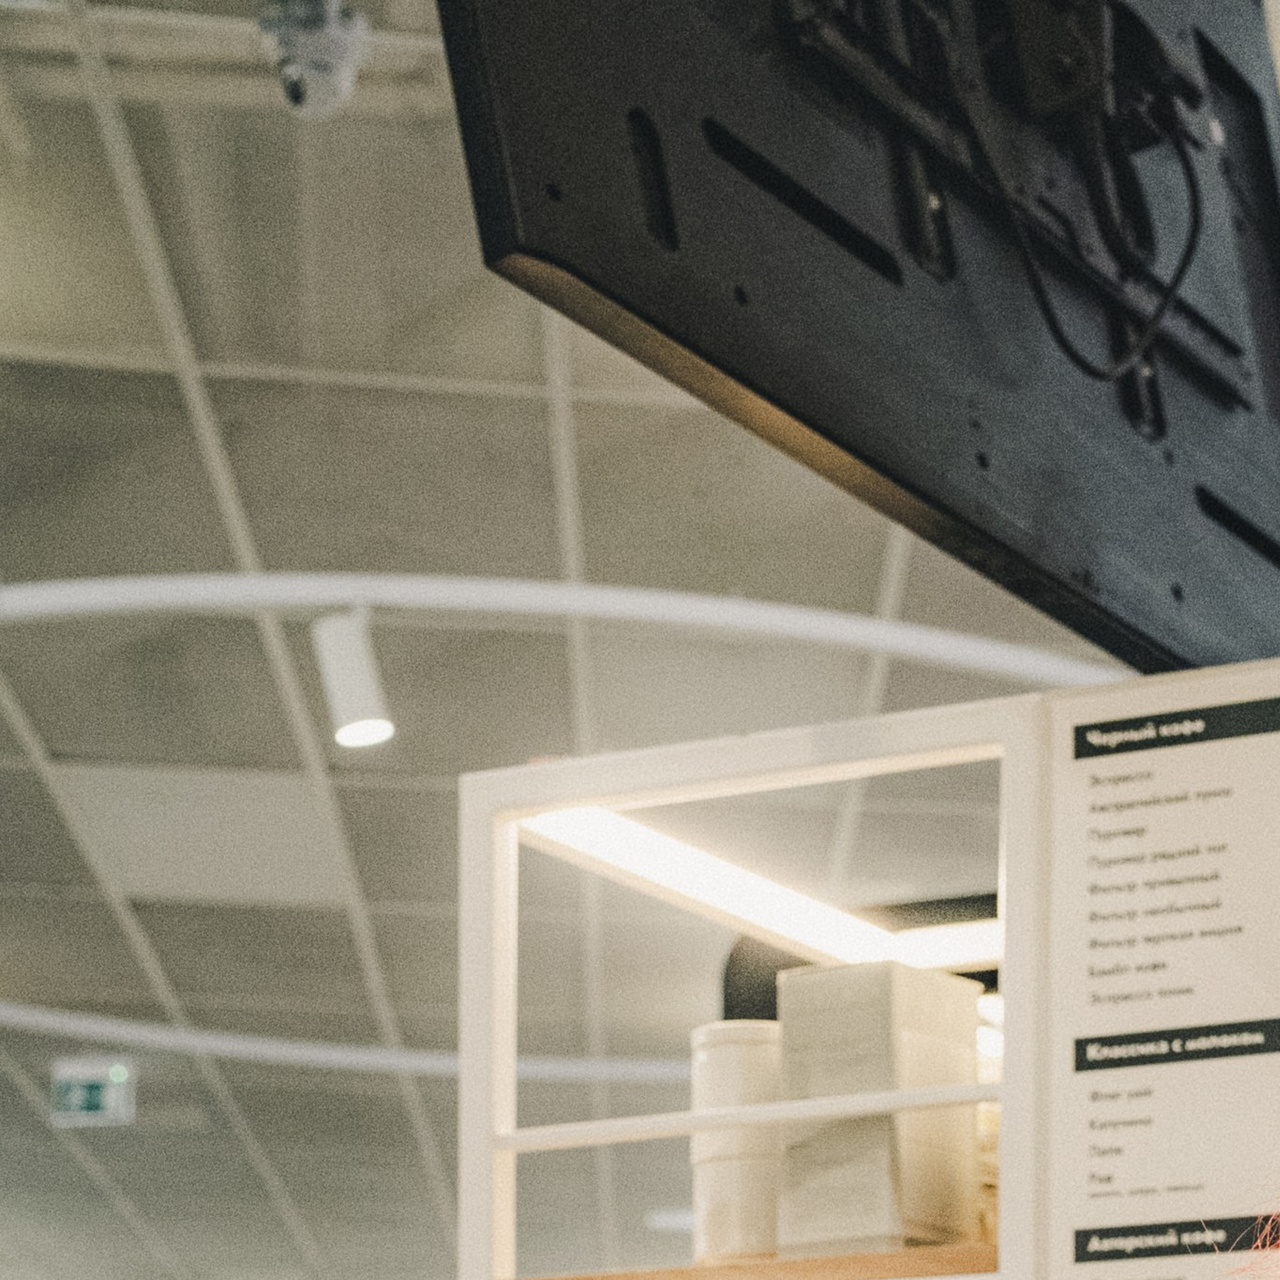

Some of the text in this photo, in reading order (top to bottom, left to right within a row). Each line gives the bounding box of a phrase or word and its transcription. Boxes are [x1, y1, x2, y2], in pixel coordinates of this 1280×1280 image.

[1087, 722, 1155, 748] Черный
[1160, 720, 1203, 737] кофе
[1087, 1031, 1265, 1061] Классика с молоком
[1087, 1229, 1225, 1253] Авторский кофе
